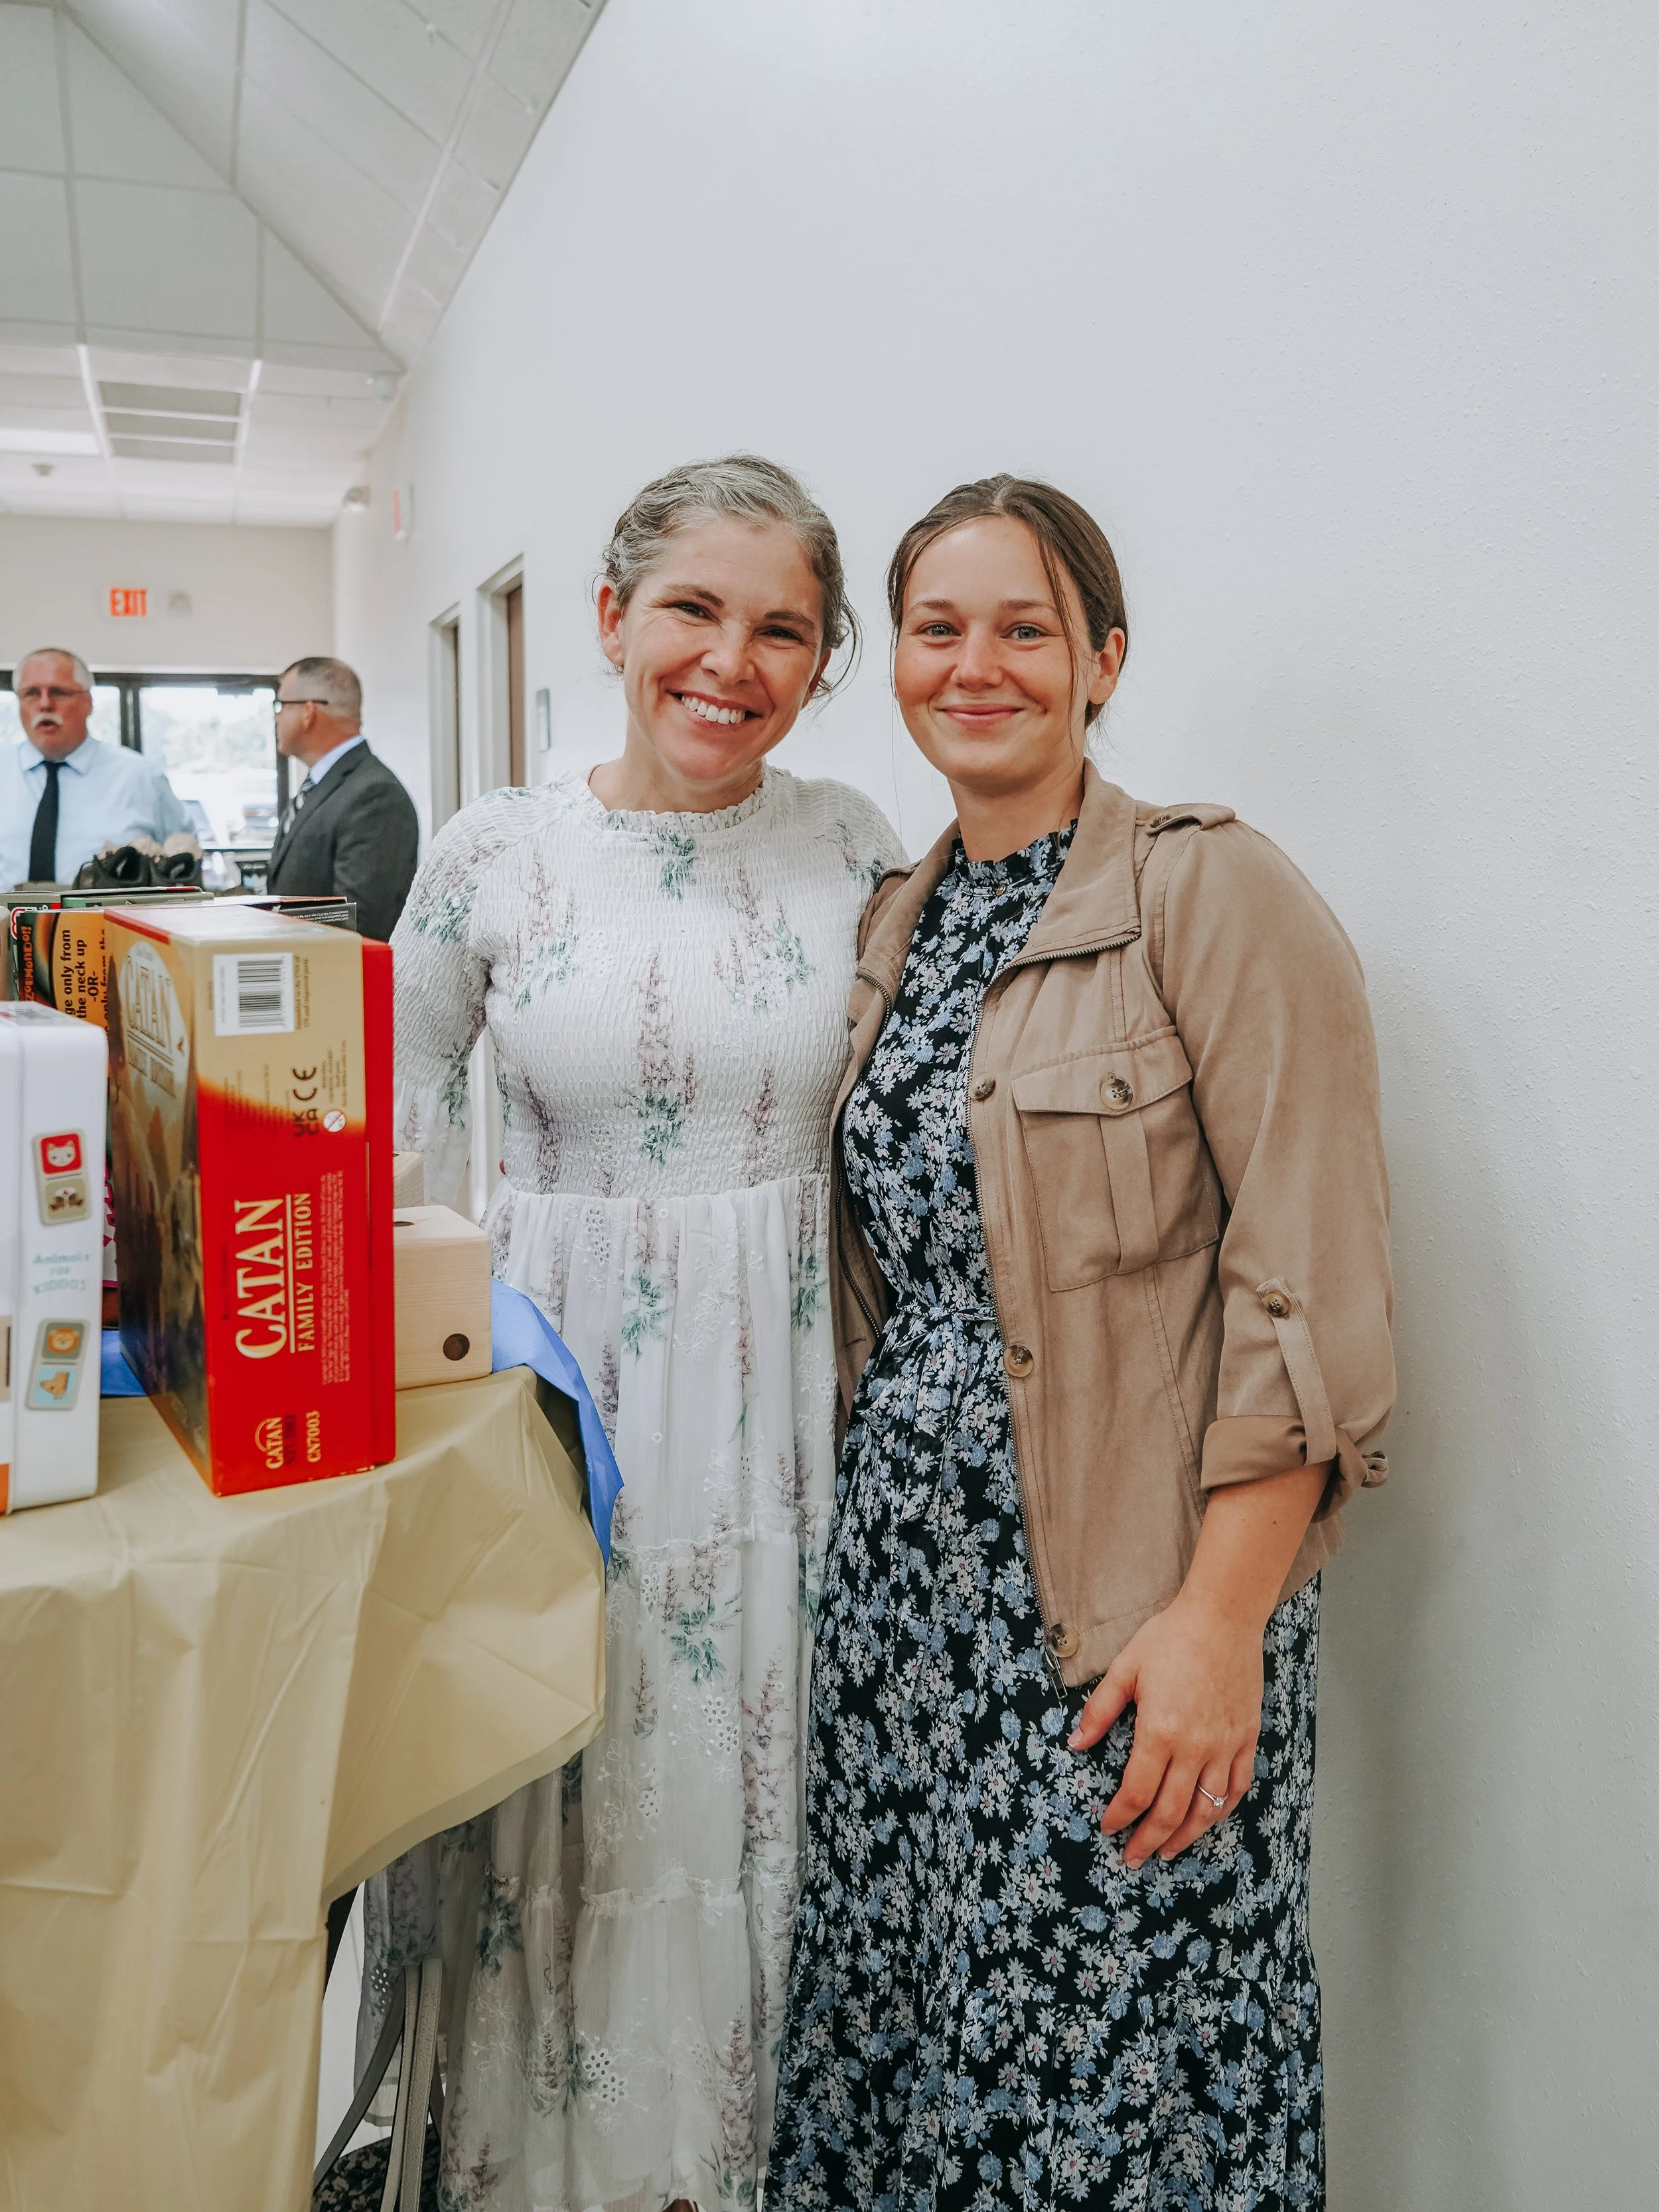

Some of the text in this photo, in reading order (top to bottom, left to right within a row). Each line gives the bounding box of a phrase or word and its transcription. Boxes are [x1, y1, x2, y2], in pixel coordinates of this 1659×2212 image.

[110, 588, 147, 617] EXIT
[60, 930, 76, 1015] ge only from
[74, 939, 87, 1019] the neck up
[293, 1110, 304, 1137] UK
[235, 1199, 287, 1359] CATAN
[294, 1193, 315, 1351] FAMILY EDITION
[265, 1417, 284, 1469] CATAN
[306, 1410, 321, 1463] CN7003
